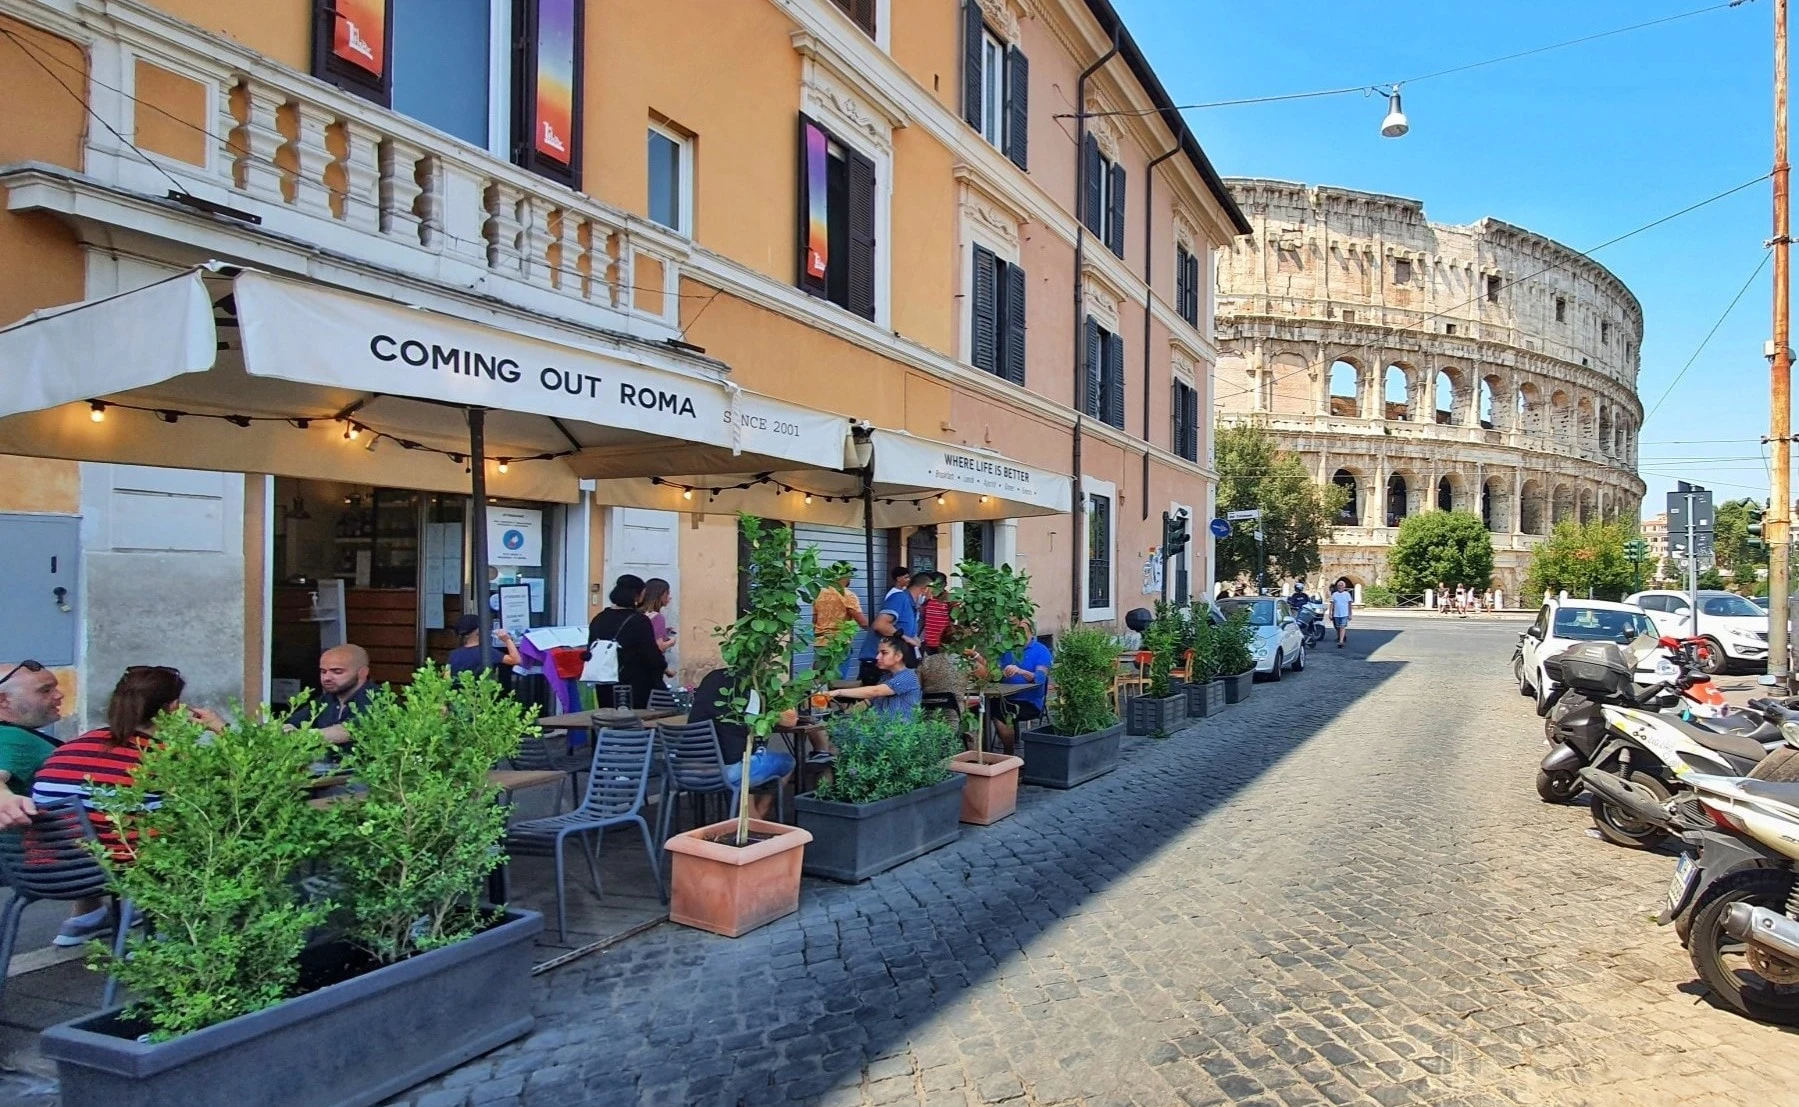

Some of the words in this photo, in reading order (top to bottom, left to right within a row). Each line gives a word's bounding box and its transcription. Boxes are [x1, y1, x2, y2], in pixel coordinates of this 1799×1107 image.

[370, 334, 521, 383] COMING
[540, 367, 602, 398] OUT
[620, 382, 697, 418] ROMA
[723, 410, 767, 430] SNCE
[773, 421, 800, 437] 2001
[944, 453, 974, 470] WHERE
[976, 460, 993, 474] LIFE
[994, 464, 1002, 476] IS
[1004, 466, 1030, 482] BETTER
